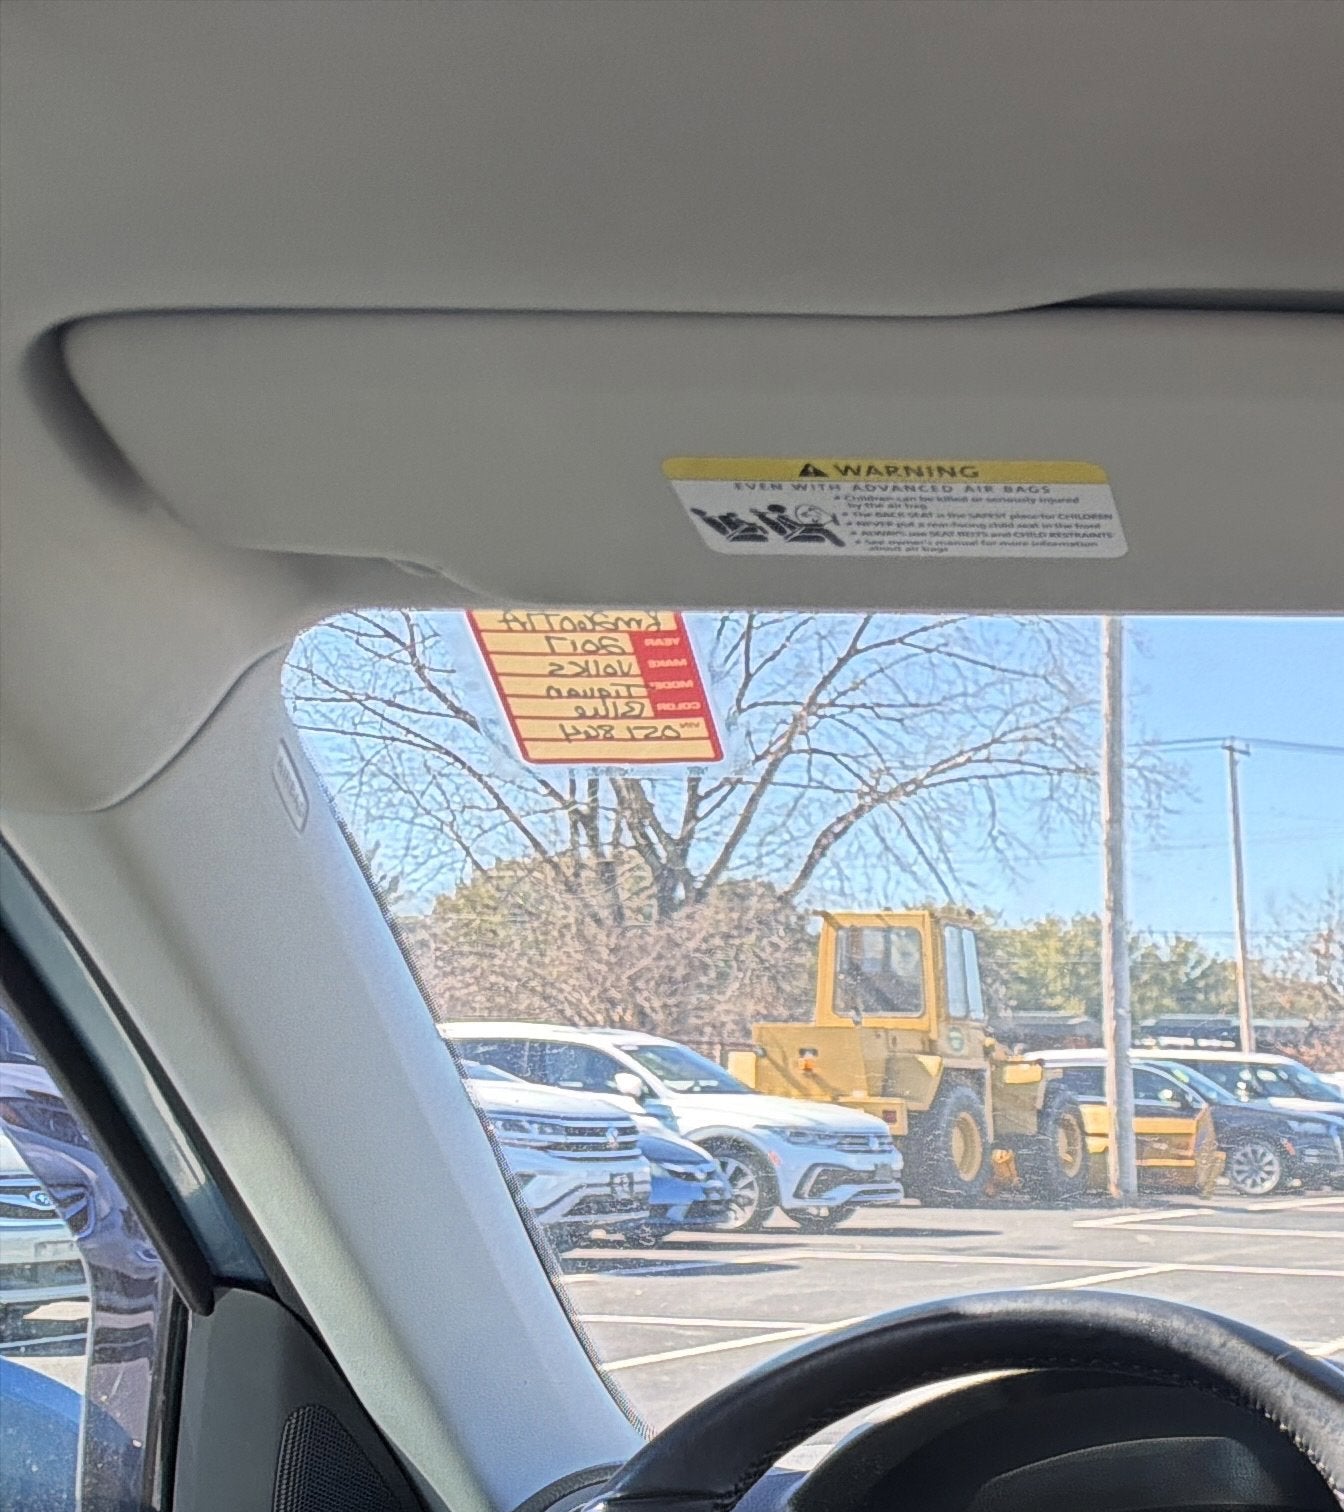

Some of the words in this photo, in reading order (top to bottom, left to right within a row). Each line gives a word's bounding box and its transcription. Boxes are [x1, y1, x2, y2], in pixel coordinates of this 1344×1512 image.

[833, 464, 979, 478] WARNING
[734, 483, 783, 491] EVEN
[791, 483, 841, 492] WITH
[852, 484, 953, 493] ADVANCED
[964, 485, 993, 493] AIR
[1003, 485, 1051, 494] BAGS
